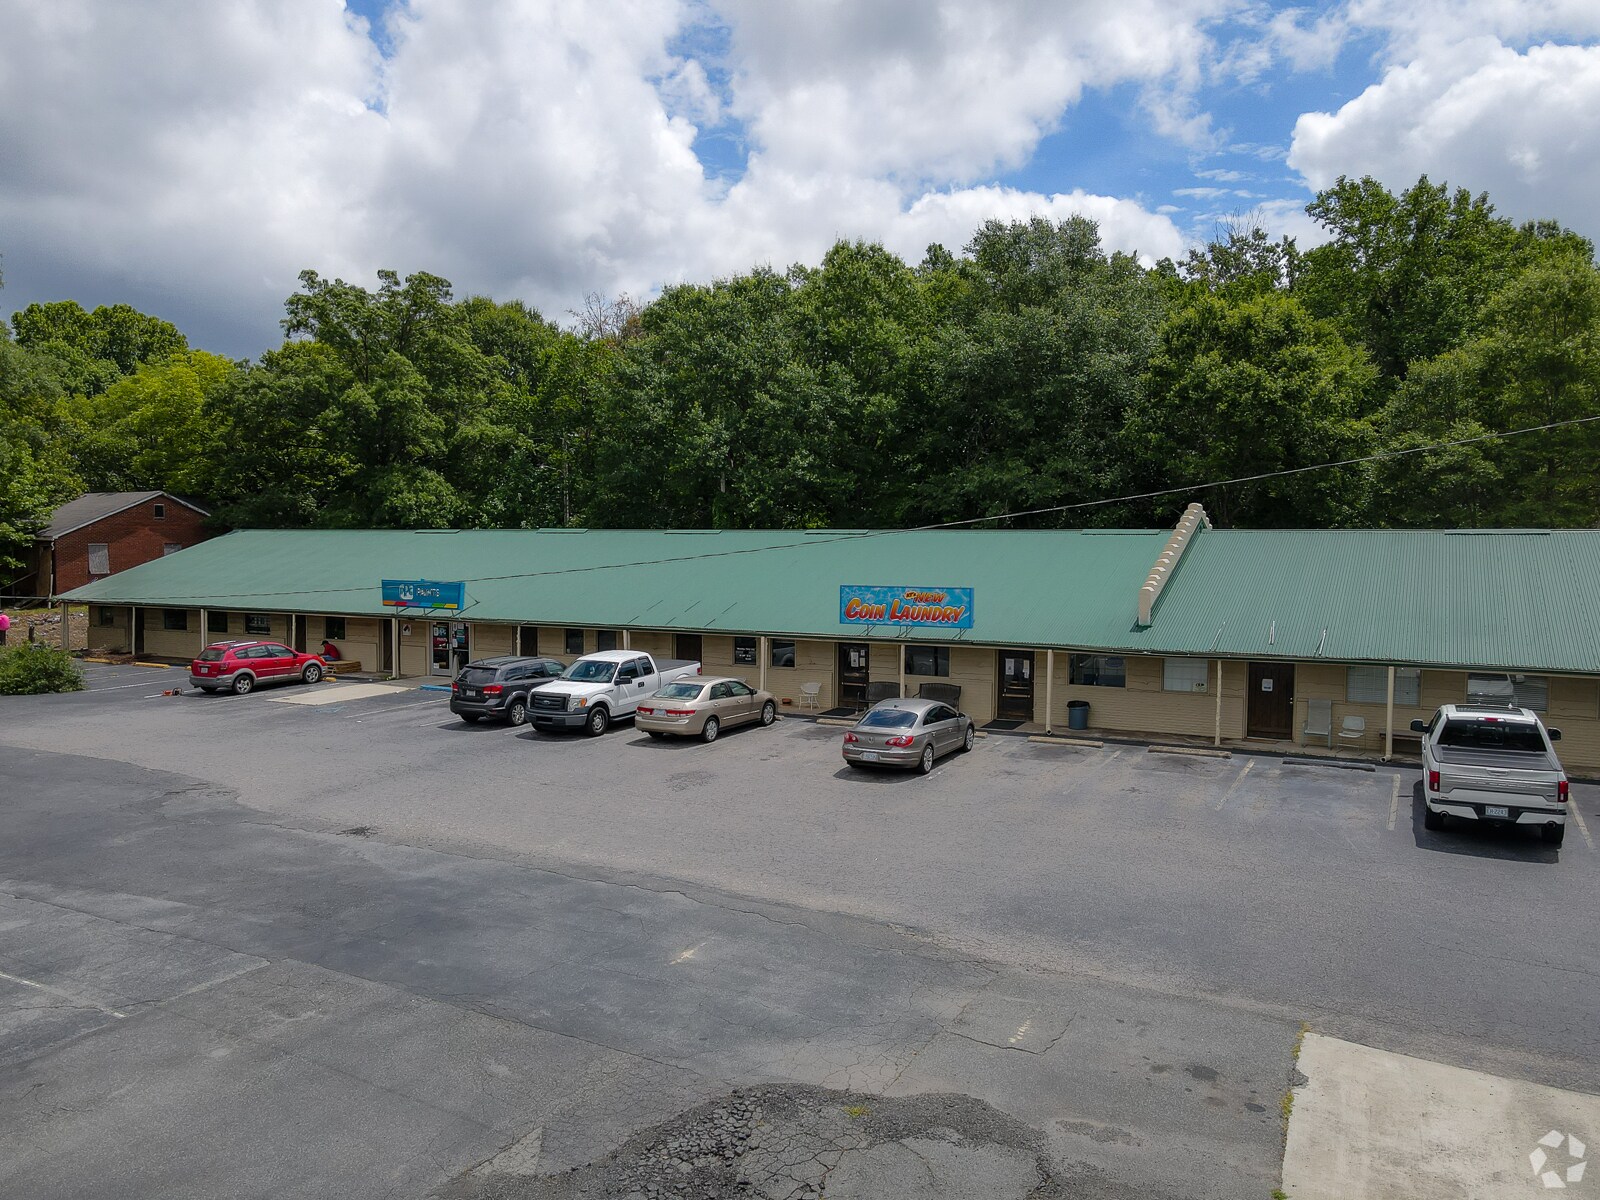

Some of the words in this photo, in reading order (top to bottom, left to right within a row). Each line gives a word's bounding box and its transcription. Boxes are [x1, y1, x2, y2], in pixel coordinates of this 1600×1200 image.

[914, 592, 946, 603] NEW
[845, 598, 887, 621] COIN
[889, 598, 966, 623] LAUNDRY
